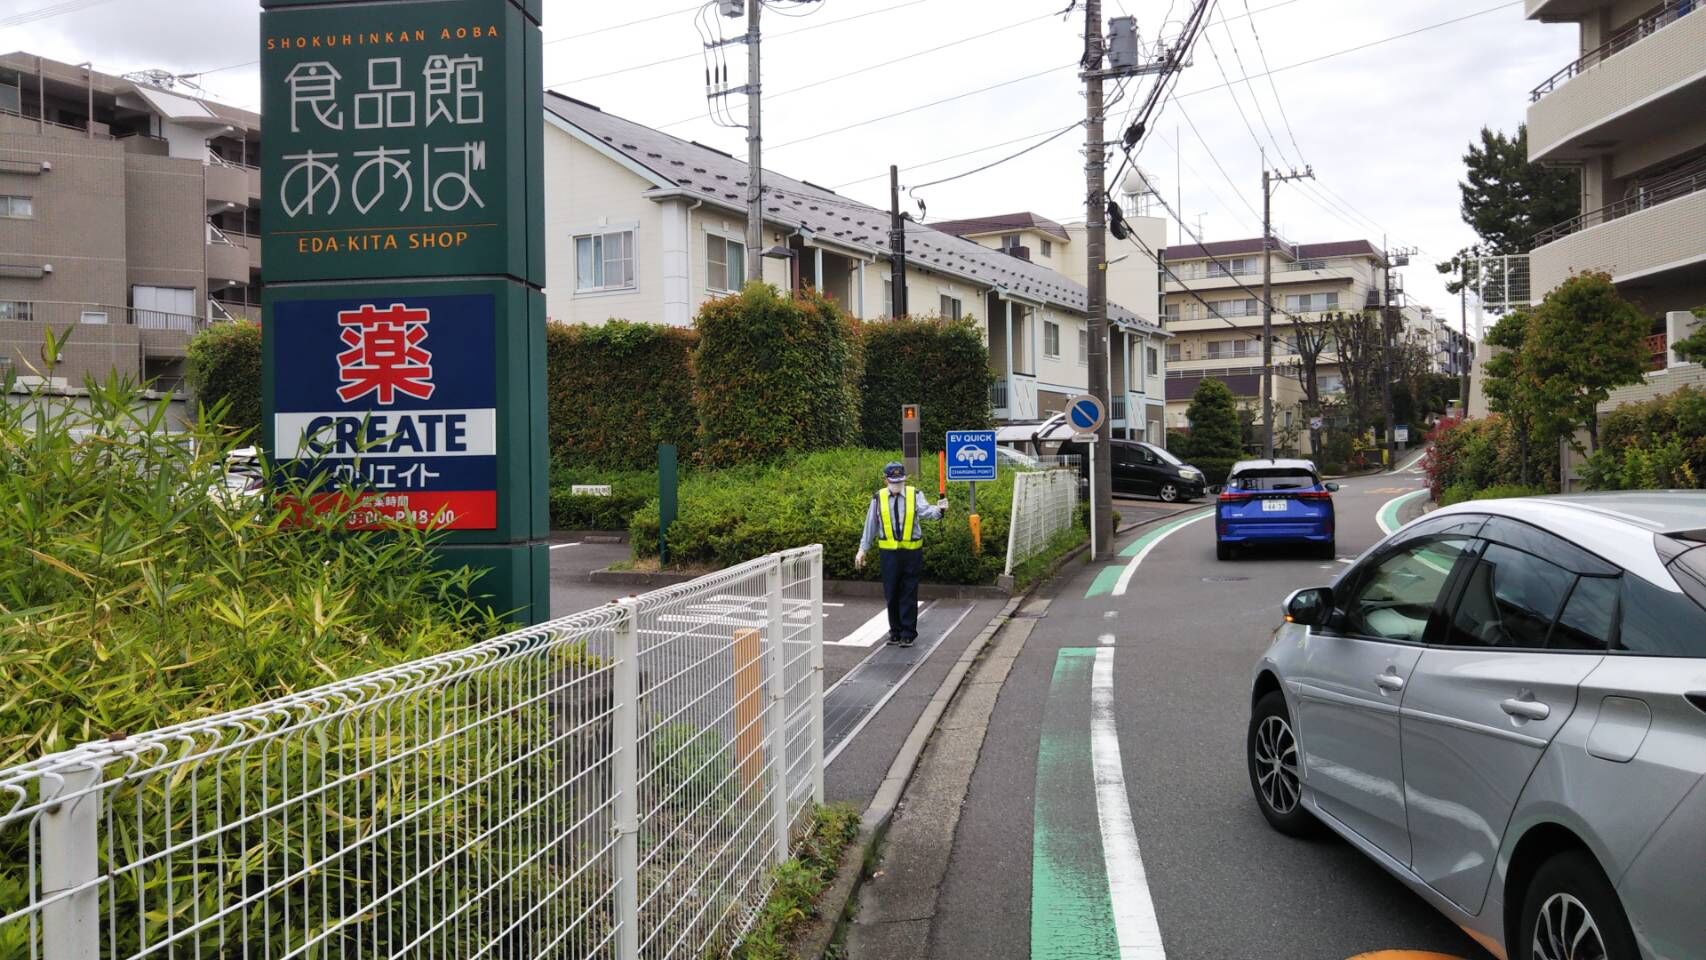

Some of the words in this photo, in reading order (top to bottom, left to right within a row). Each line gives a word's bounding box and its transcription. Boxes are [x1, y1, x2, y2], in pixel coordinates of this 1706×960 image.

[267, 30, 425, 50] SHOKUHINKAN
[441, 25, 498, 40] AOBA
[284, 53, 484, 133] 食品館
[280, 140, 486, 218] あおば
[299, 233, 398, 253] EDA-KITA
[408, 231, 468, 249] SHOP
[336, 303, 436, 405] 薬
[305, 413, 467, 454] CREATE
[963, 434, 992, 442] QUICK
[332, 463, 440, 489] クリエイト
